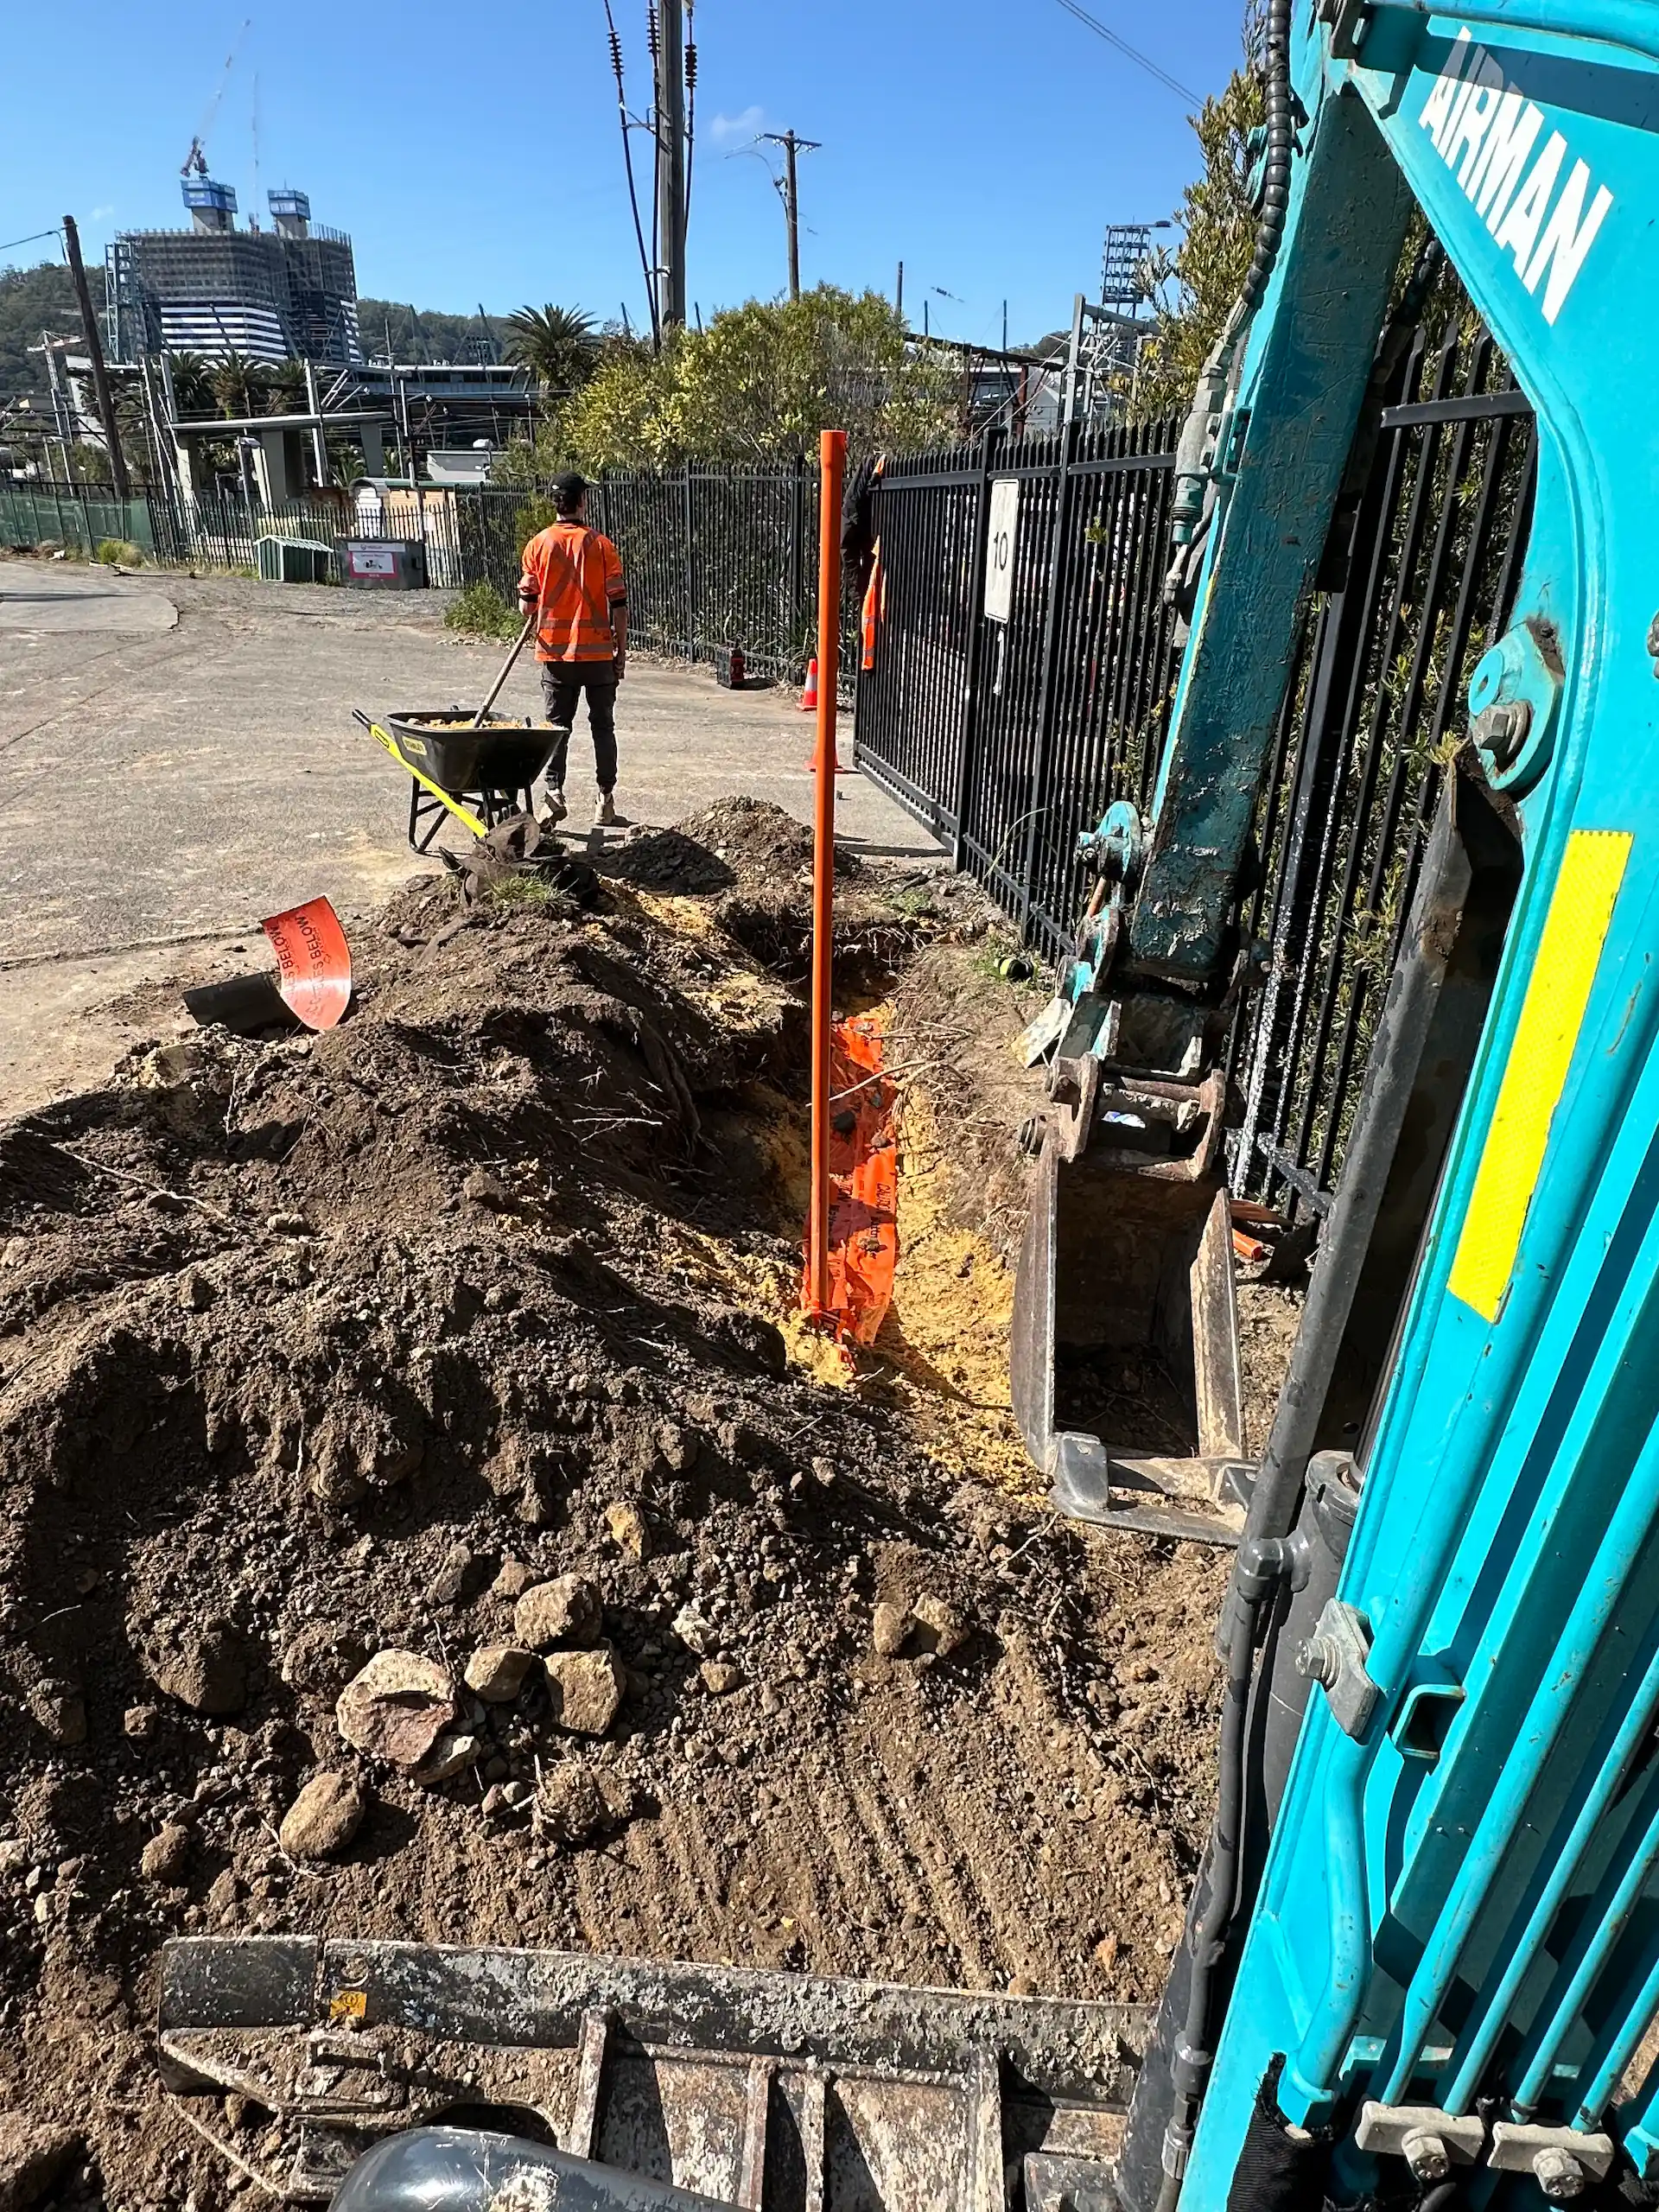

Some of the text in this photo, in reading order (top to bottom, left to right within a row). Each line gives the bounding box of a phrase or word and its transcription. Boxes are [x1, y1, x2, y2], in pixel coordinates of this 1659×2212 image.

[1418, 25, 1614, 327] AIRMAN
[993, 531, 1008, 571] 10
[269, 925, 294, 970] BELOW
[295, 914, 322, 960] BELOW
